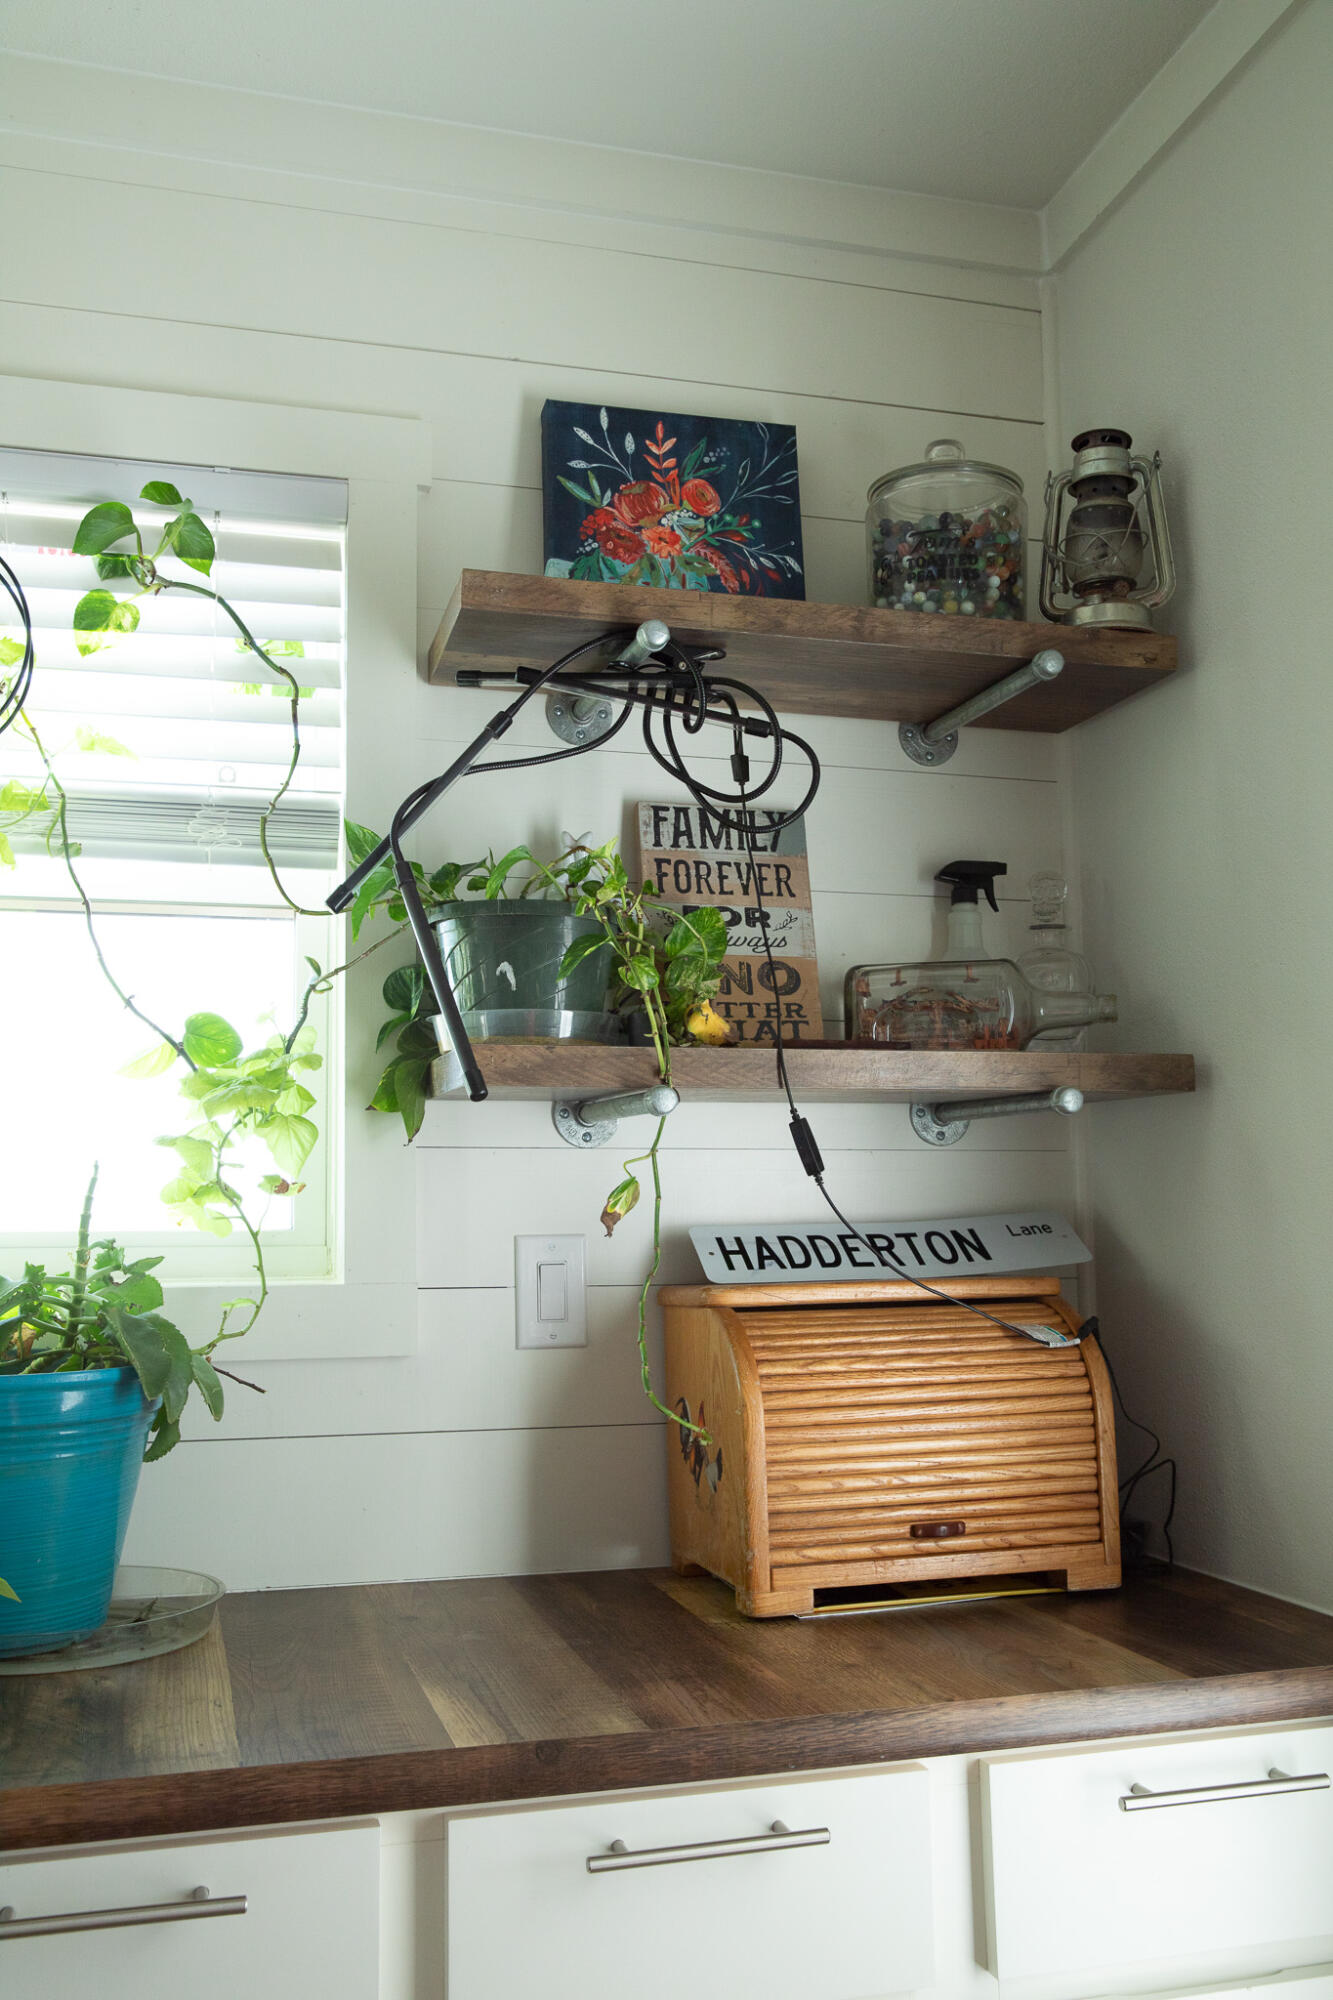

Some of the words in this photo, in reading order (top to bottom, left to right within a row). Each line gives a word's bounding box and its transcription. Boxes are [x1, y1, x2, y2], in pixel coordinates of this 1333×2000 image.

[651, 805, 787, 852] FAMILY
[654, 858, 796, 897] FOREVER
[682, 905, 771, 928] OR
[717, 960, 801, 996] NO
[716, 1001, 809, 1019] TTER
[715, 1228, 992, 1271] HADDERTON
[1005, 1222, 1053, 1237] Lane
